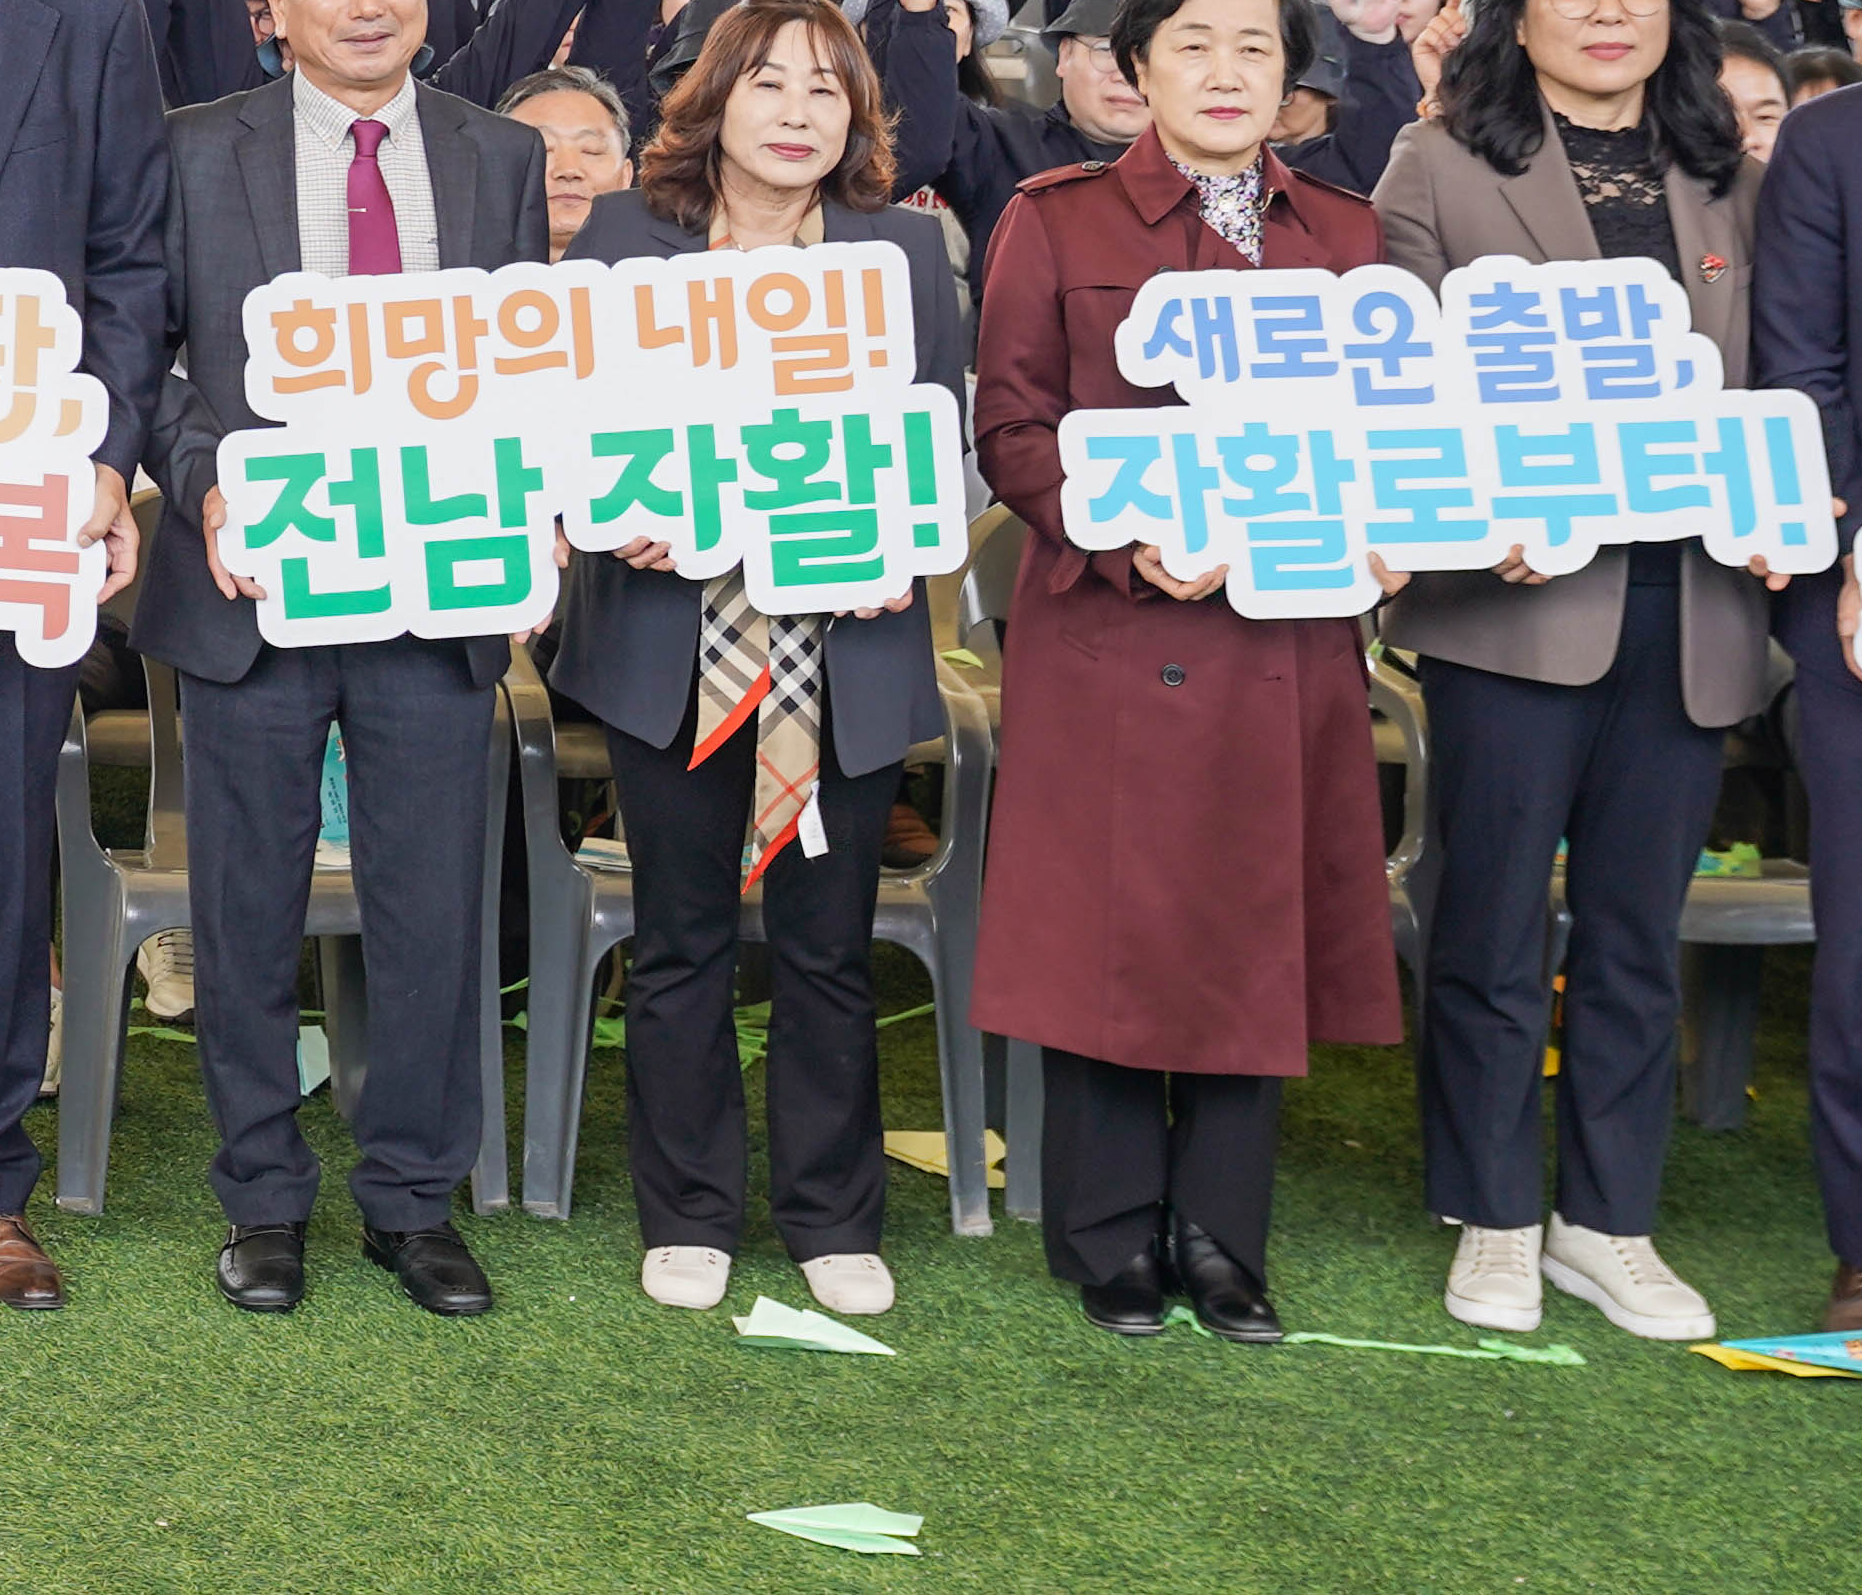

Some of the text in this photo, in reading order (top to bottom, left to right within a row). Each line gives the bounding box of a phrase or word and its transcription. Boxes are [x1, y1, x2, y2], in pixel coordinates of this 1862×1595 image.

[270, 266, 888, 421] 희망의 내일!
[1142, 280, 1695, 406] 새로운 출발,
[243, 406, 941, 621] 전남 자활!
[1084, 416, 1810, 593] 자활로부터!
